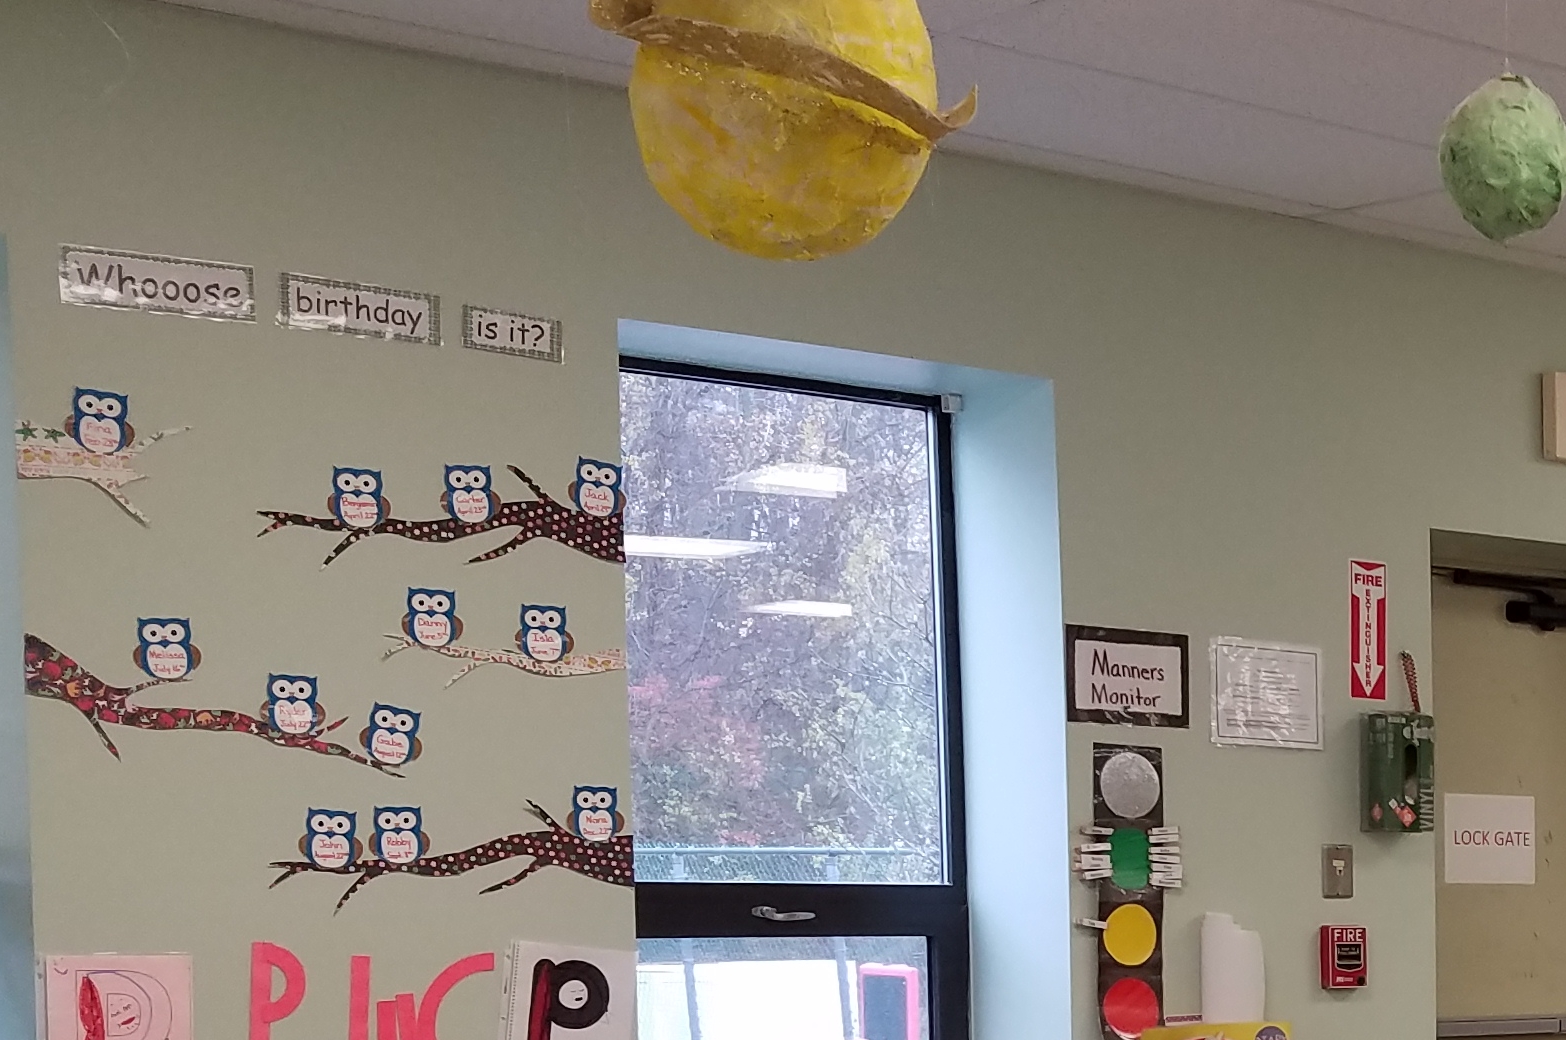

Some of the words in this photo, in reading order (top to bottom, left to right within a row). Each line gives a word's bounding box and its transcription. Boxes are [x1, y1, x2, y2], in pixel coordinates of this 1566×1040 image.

[76, 261, 242, 308] Whooose
[296, 288, 423, 335] birthday
[476, 315, 499, 341] is
[509, 321, 545, 347] it?
[585, 488, 609, 502] Jack
[1354, 573, 1382, 587] FIRE
[531, 632, 555, 643] Isla
[1364, 589, 1372, 688] EXTINGUISHER
[153, 663, 171, 675] July
[1091, 649, 1165, 682] Manners
[1090, 683, 1161, 708] Monitor
[377, 734, 405, 748] Gabe
[1454, 830, 1490, 846] LOCK
[1494, 831, 1531, 847] GATE
[1334, 929, 1363, 942] FIRE
